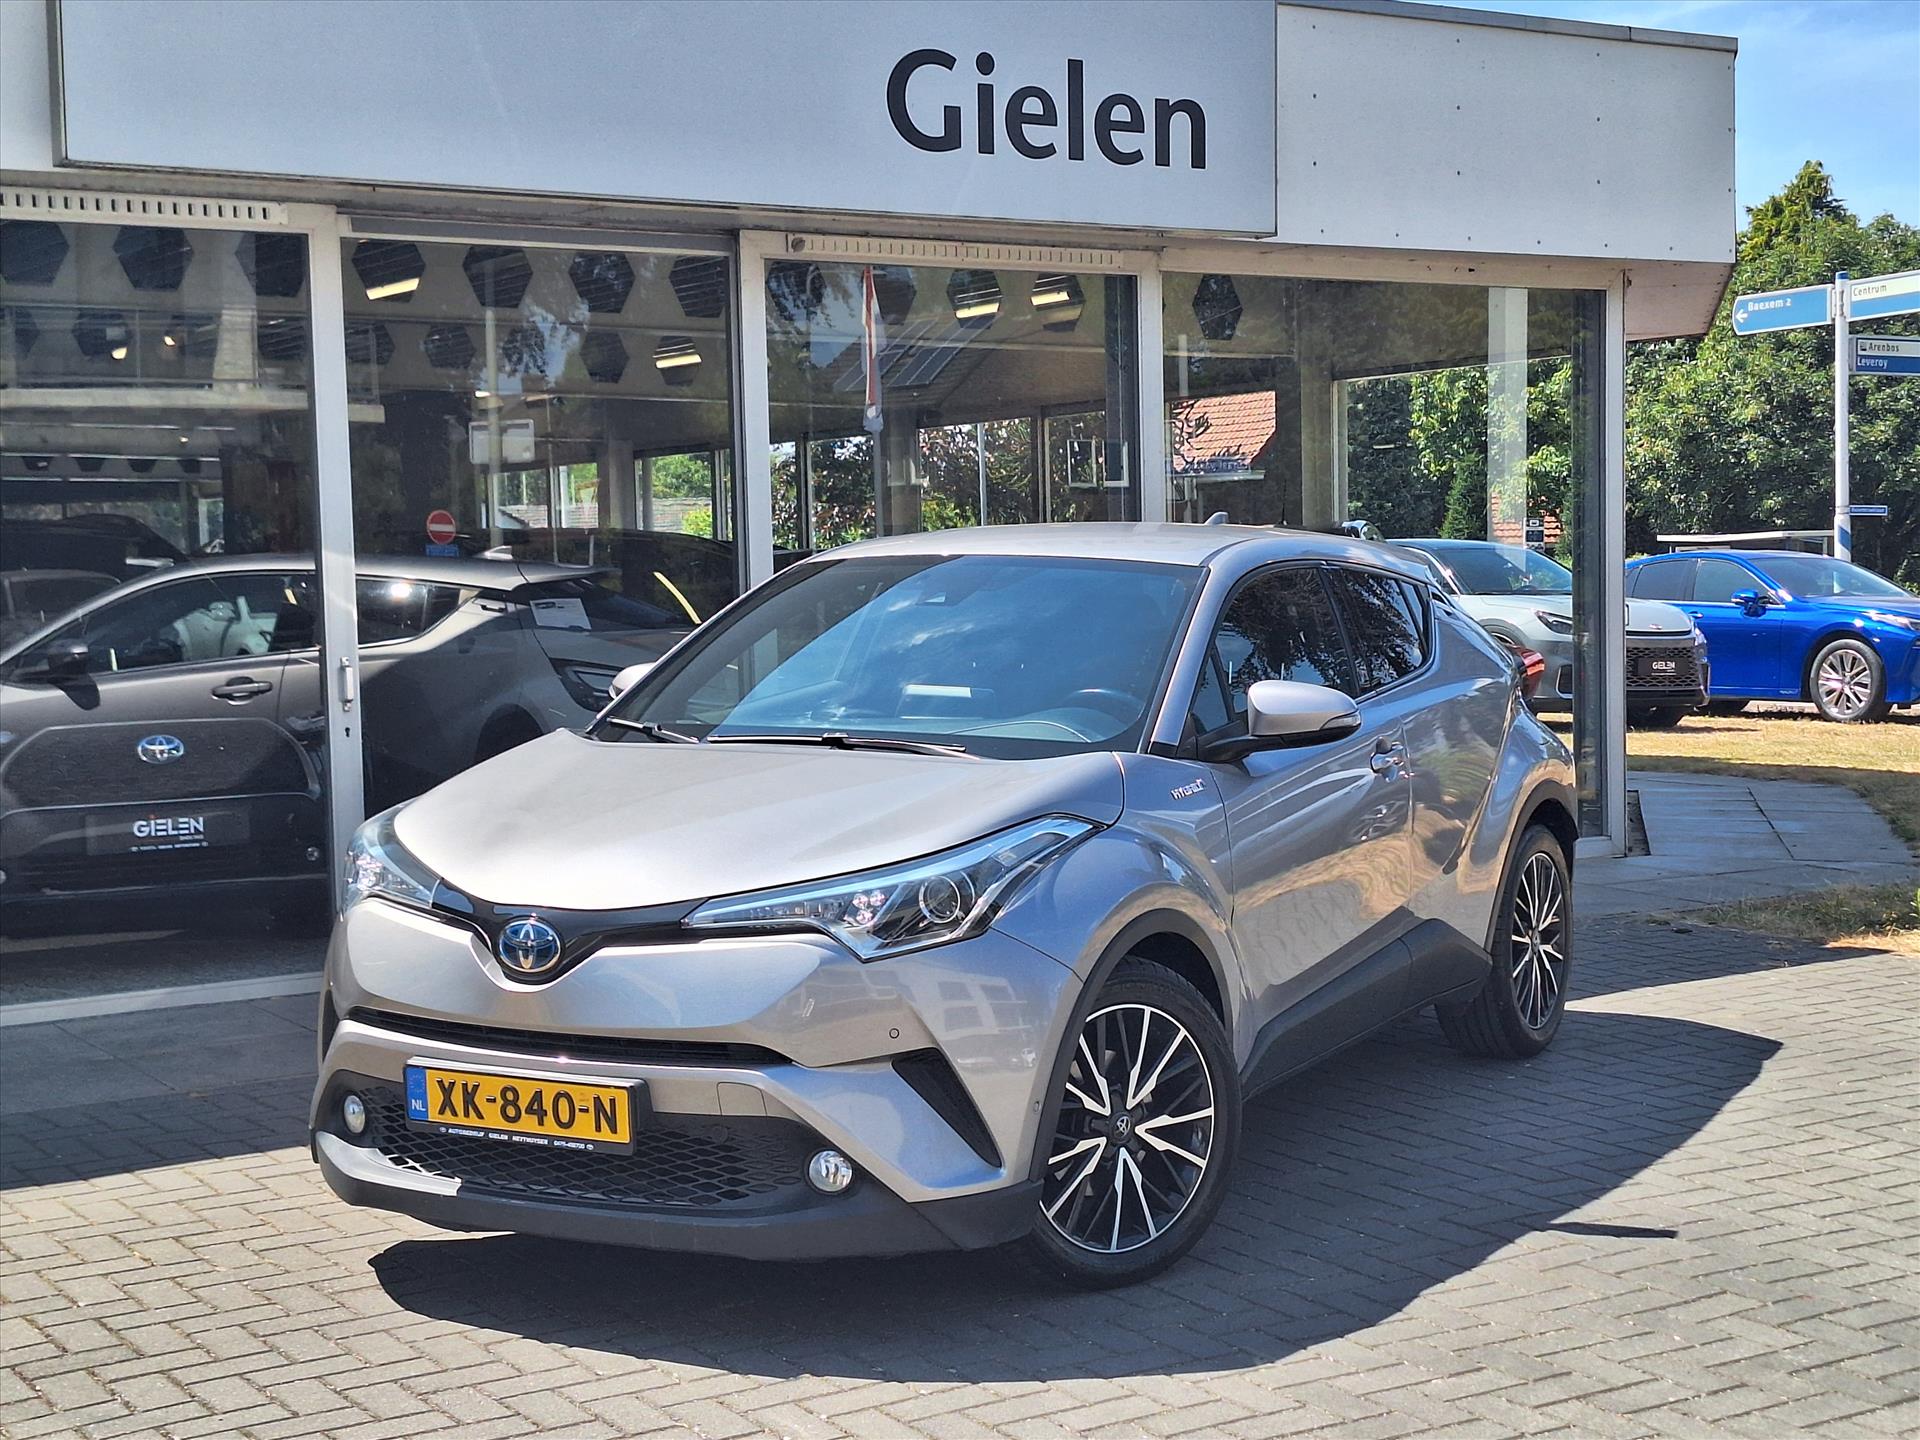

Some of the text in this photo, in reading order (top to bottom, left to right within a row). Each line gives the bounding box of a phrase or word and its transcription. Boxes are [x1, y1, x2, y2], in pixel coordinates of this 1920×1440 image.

[886, 48, 1207, 170] Gielen
[1853, 284, 1887, 297] Centrum
[1748, 297, 1792, 311] Baexem 2
[1857, 356, 1888, 369] Leveroy
[133, 816, 204, 837] GIELEN
[411, 1099, 427, 1112] NL
[436, 1078, 618, 1135] XK-840-N
